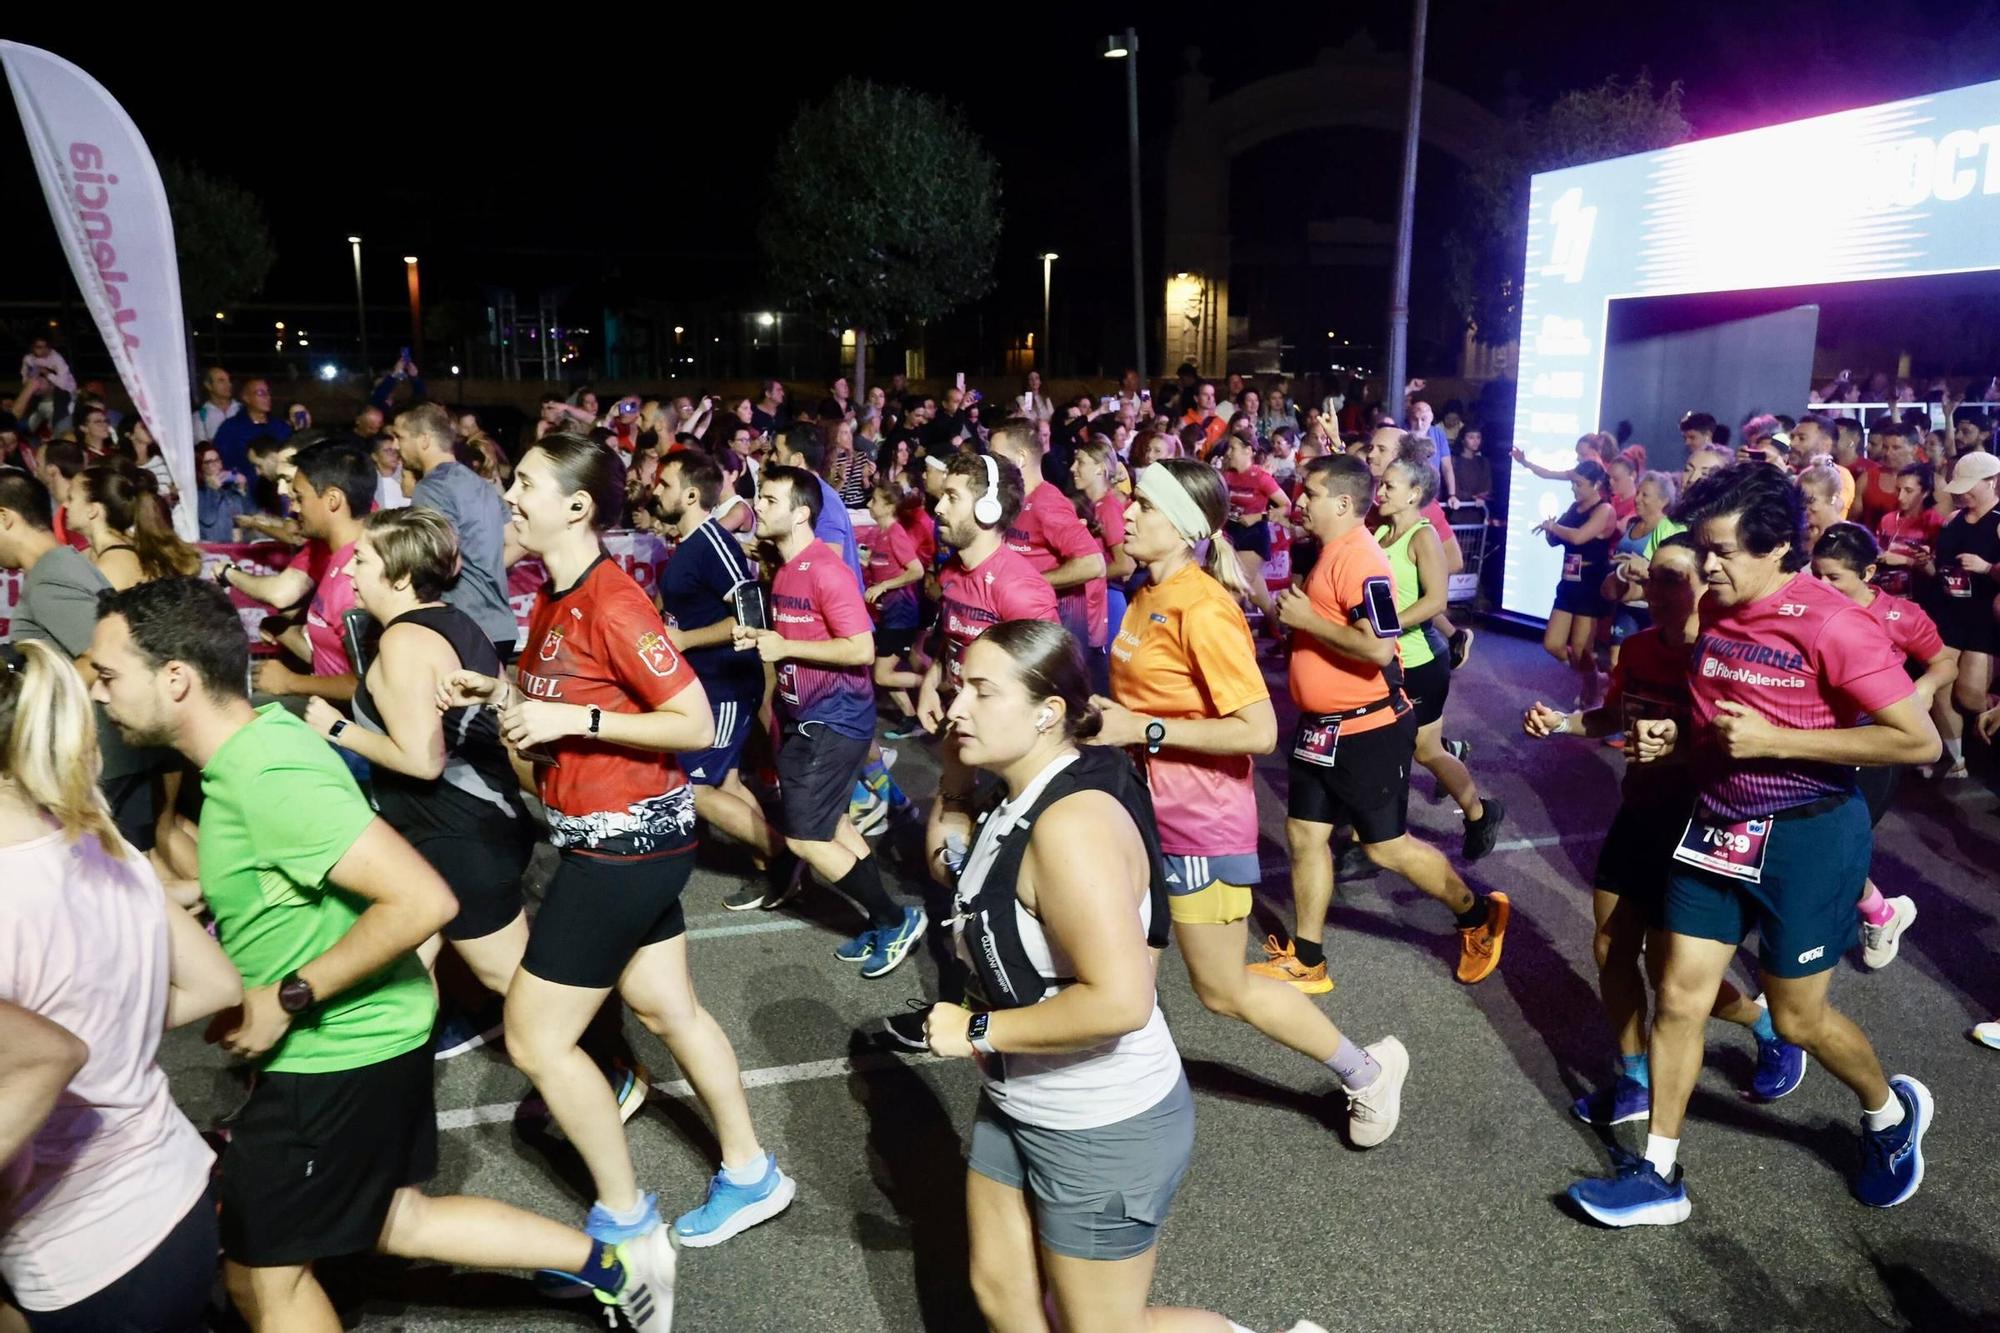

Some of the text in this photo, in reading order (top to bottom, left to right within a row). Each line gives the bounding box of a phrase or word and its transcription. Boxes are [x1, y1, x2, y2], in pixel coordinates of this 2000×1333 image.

[1711, 638, 1803, 671] NOCTURNA
[1715, 661, 1806, 688] FibraValencia
[1702, 824, 1751, 854] 7629
